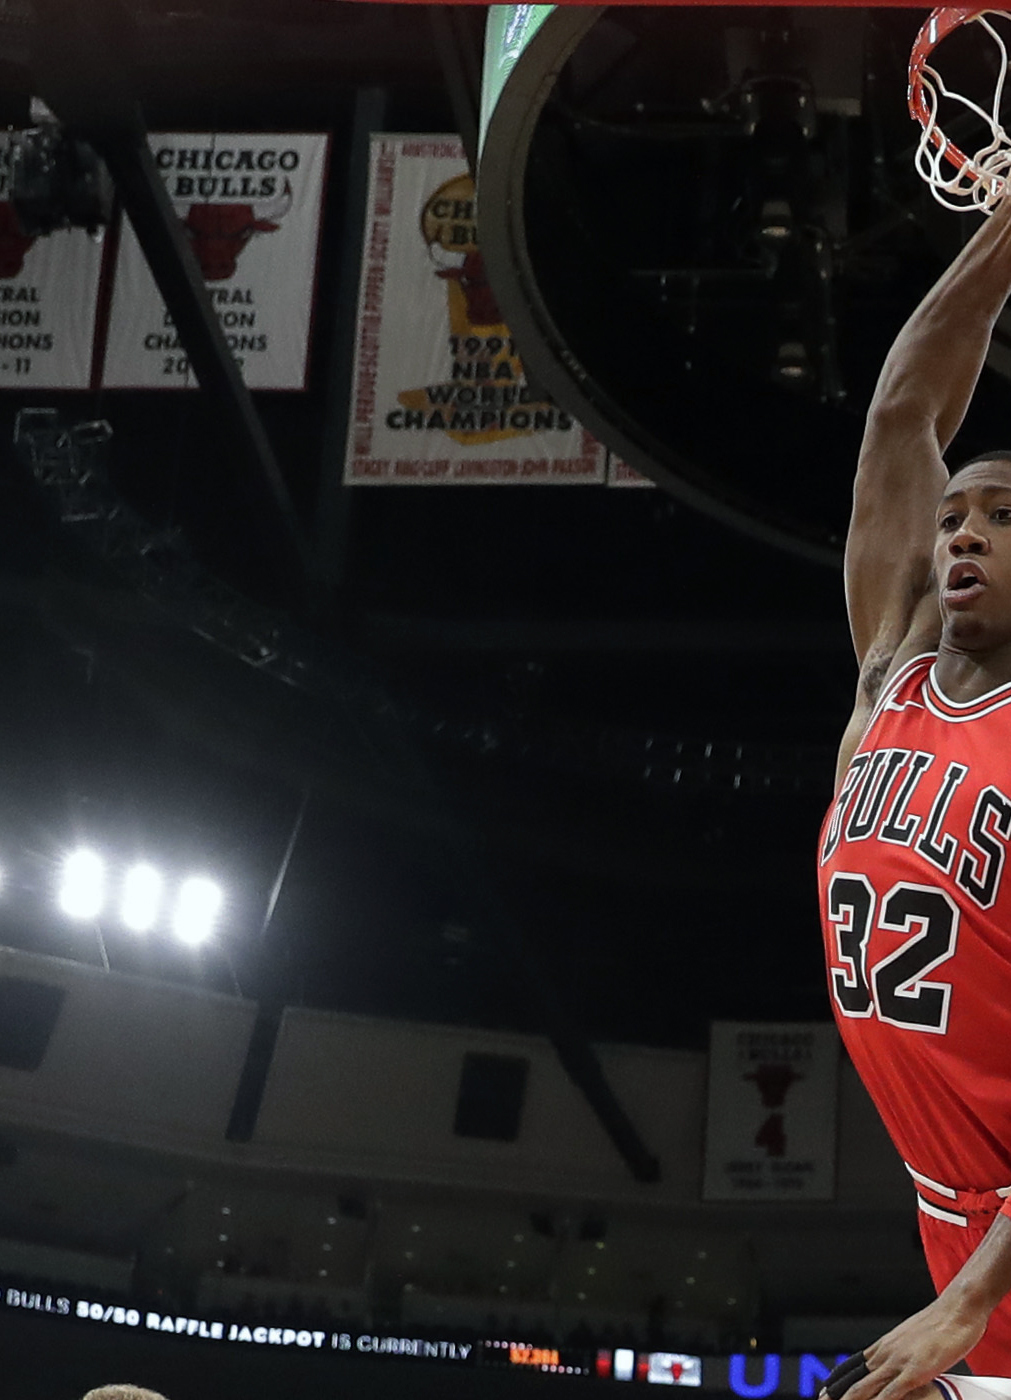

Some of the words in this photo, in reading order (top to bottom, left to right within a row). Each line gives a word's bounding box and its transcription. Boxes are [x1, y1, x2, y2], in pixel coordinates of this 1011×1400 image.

[156, 149, 299, 170] CHICAGO
[175, 177, 276, 197] BULLS
[452, 361, 512, 379] NBA
[386, 410, 572, 430] CHAMPIONS
[828, 871, 960, 1036] 32
[755, 1114, 786, 1157] 4
[6, 1288, 70, 1315] BULLS
[76, 1300, 141, 1326] 50/50
[146, 1312, 224, 1340] RAFFLE
[228, 1324, 326, 1348] JACKPOT
[331, 1333, 351, 1350] IS
